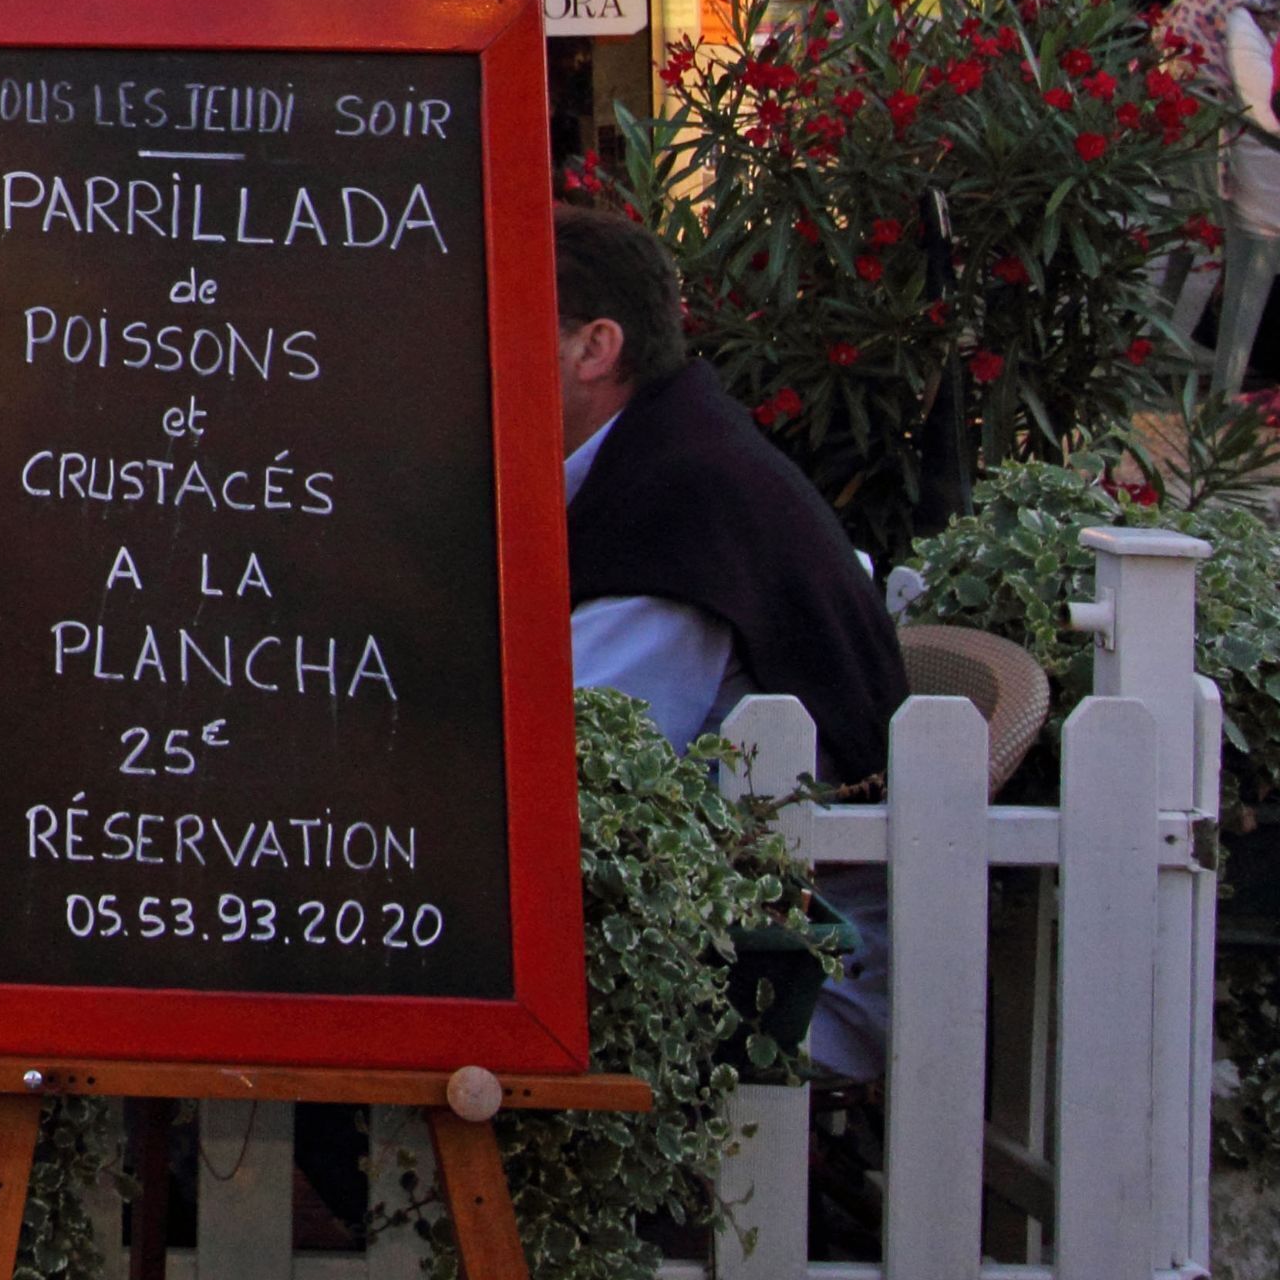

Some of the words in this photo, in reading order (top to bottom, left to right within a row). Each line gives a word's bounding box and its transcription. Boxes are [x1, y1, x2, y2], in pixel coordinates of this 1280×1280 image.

[93, 79, 170, 130] LES
[168, 266, 218, 305] de
[161, 394, 208, 437] et
[21, 448, 334, 515] CRUSTACÉS
[106, 545, 144, 590] A
[199, 552, 273, 598] LA
[49, 620, 399, 701] PLANCHA
[118, 719, 231, 776] 25€
[65, 892, 444, 948] 05.53.93.20.20
